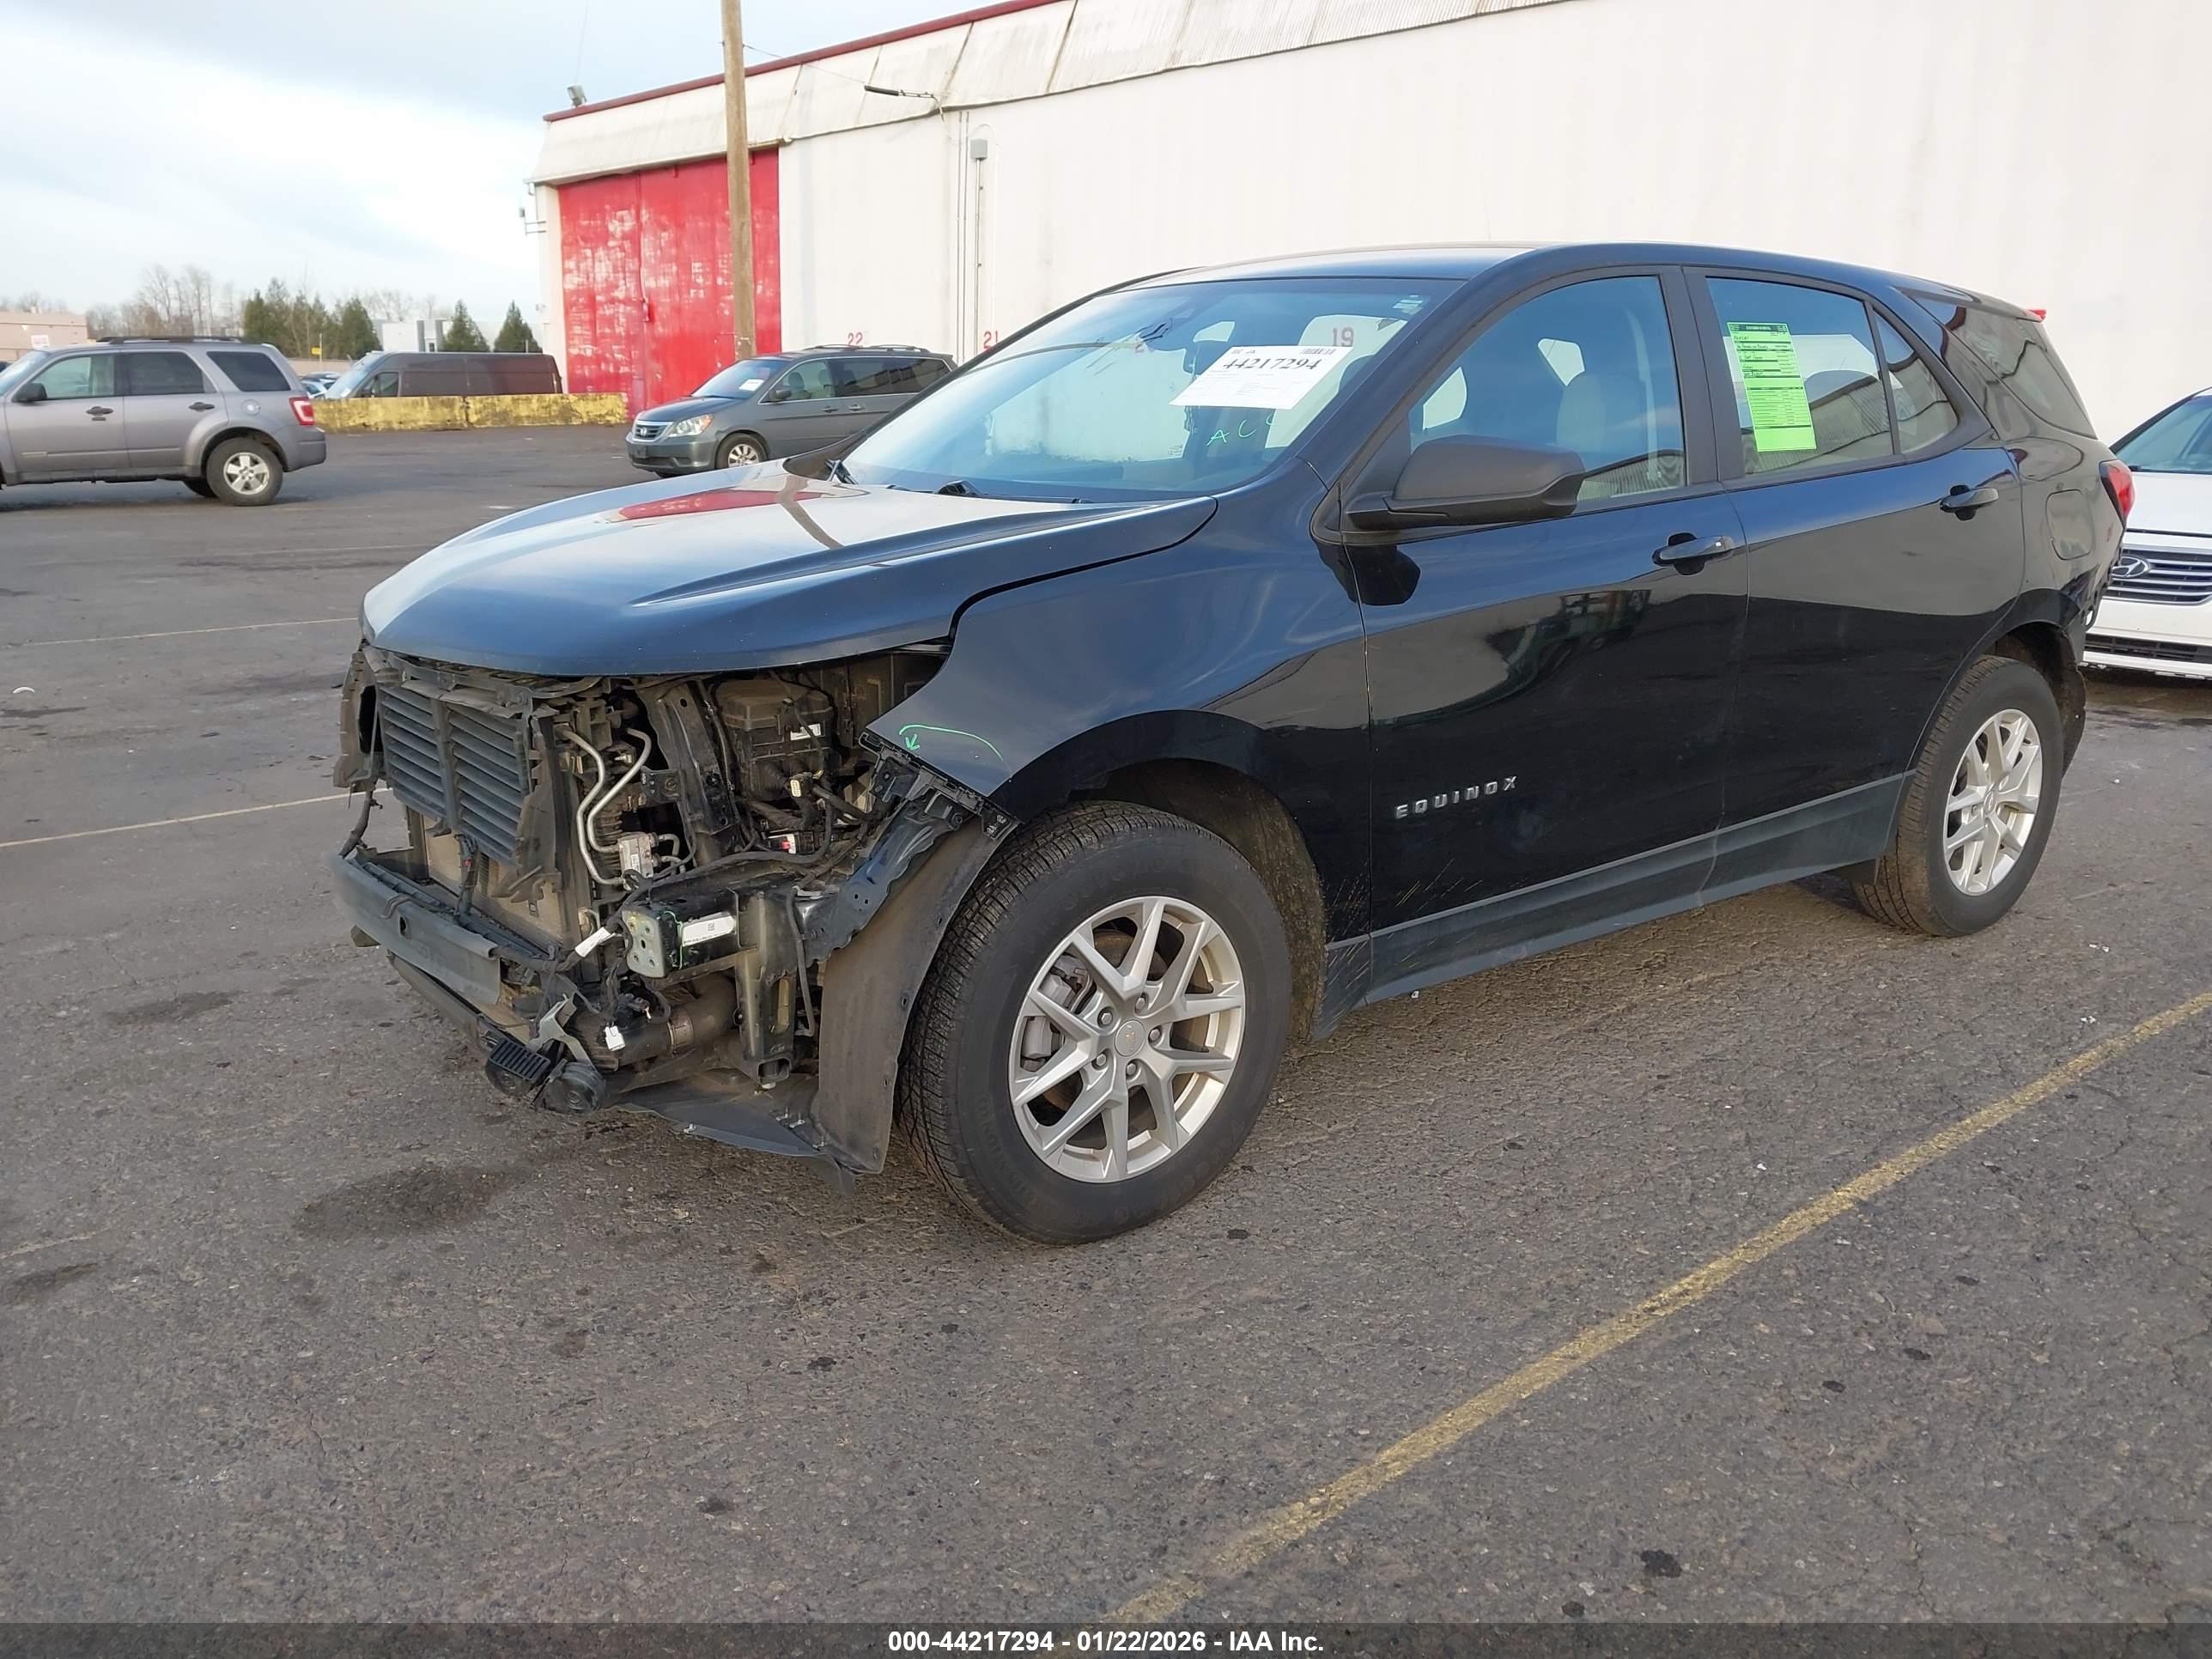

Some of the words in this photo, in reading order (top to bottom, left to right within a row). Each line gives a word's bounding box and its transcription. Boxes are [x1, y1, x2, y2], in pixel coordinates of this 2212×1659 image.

[848, 331, 863, 344] 22
[983, 331, 999, 351] 21
[1332, 327, 1354, 347] 19
[1223, 358, 1322, 370] 44217294
[1395, 775, 1517, 819] EQUINOX
